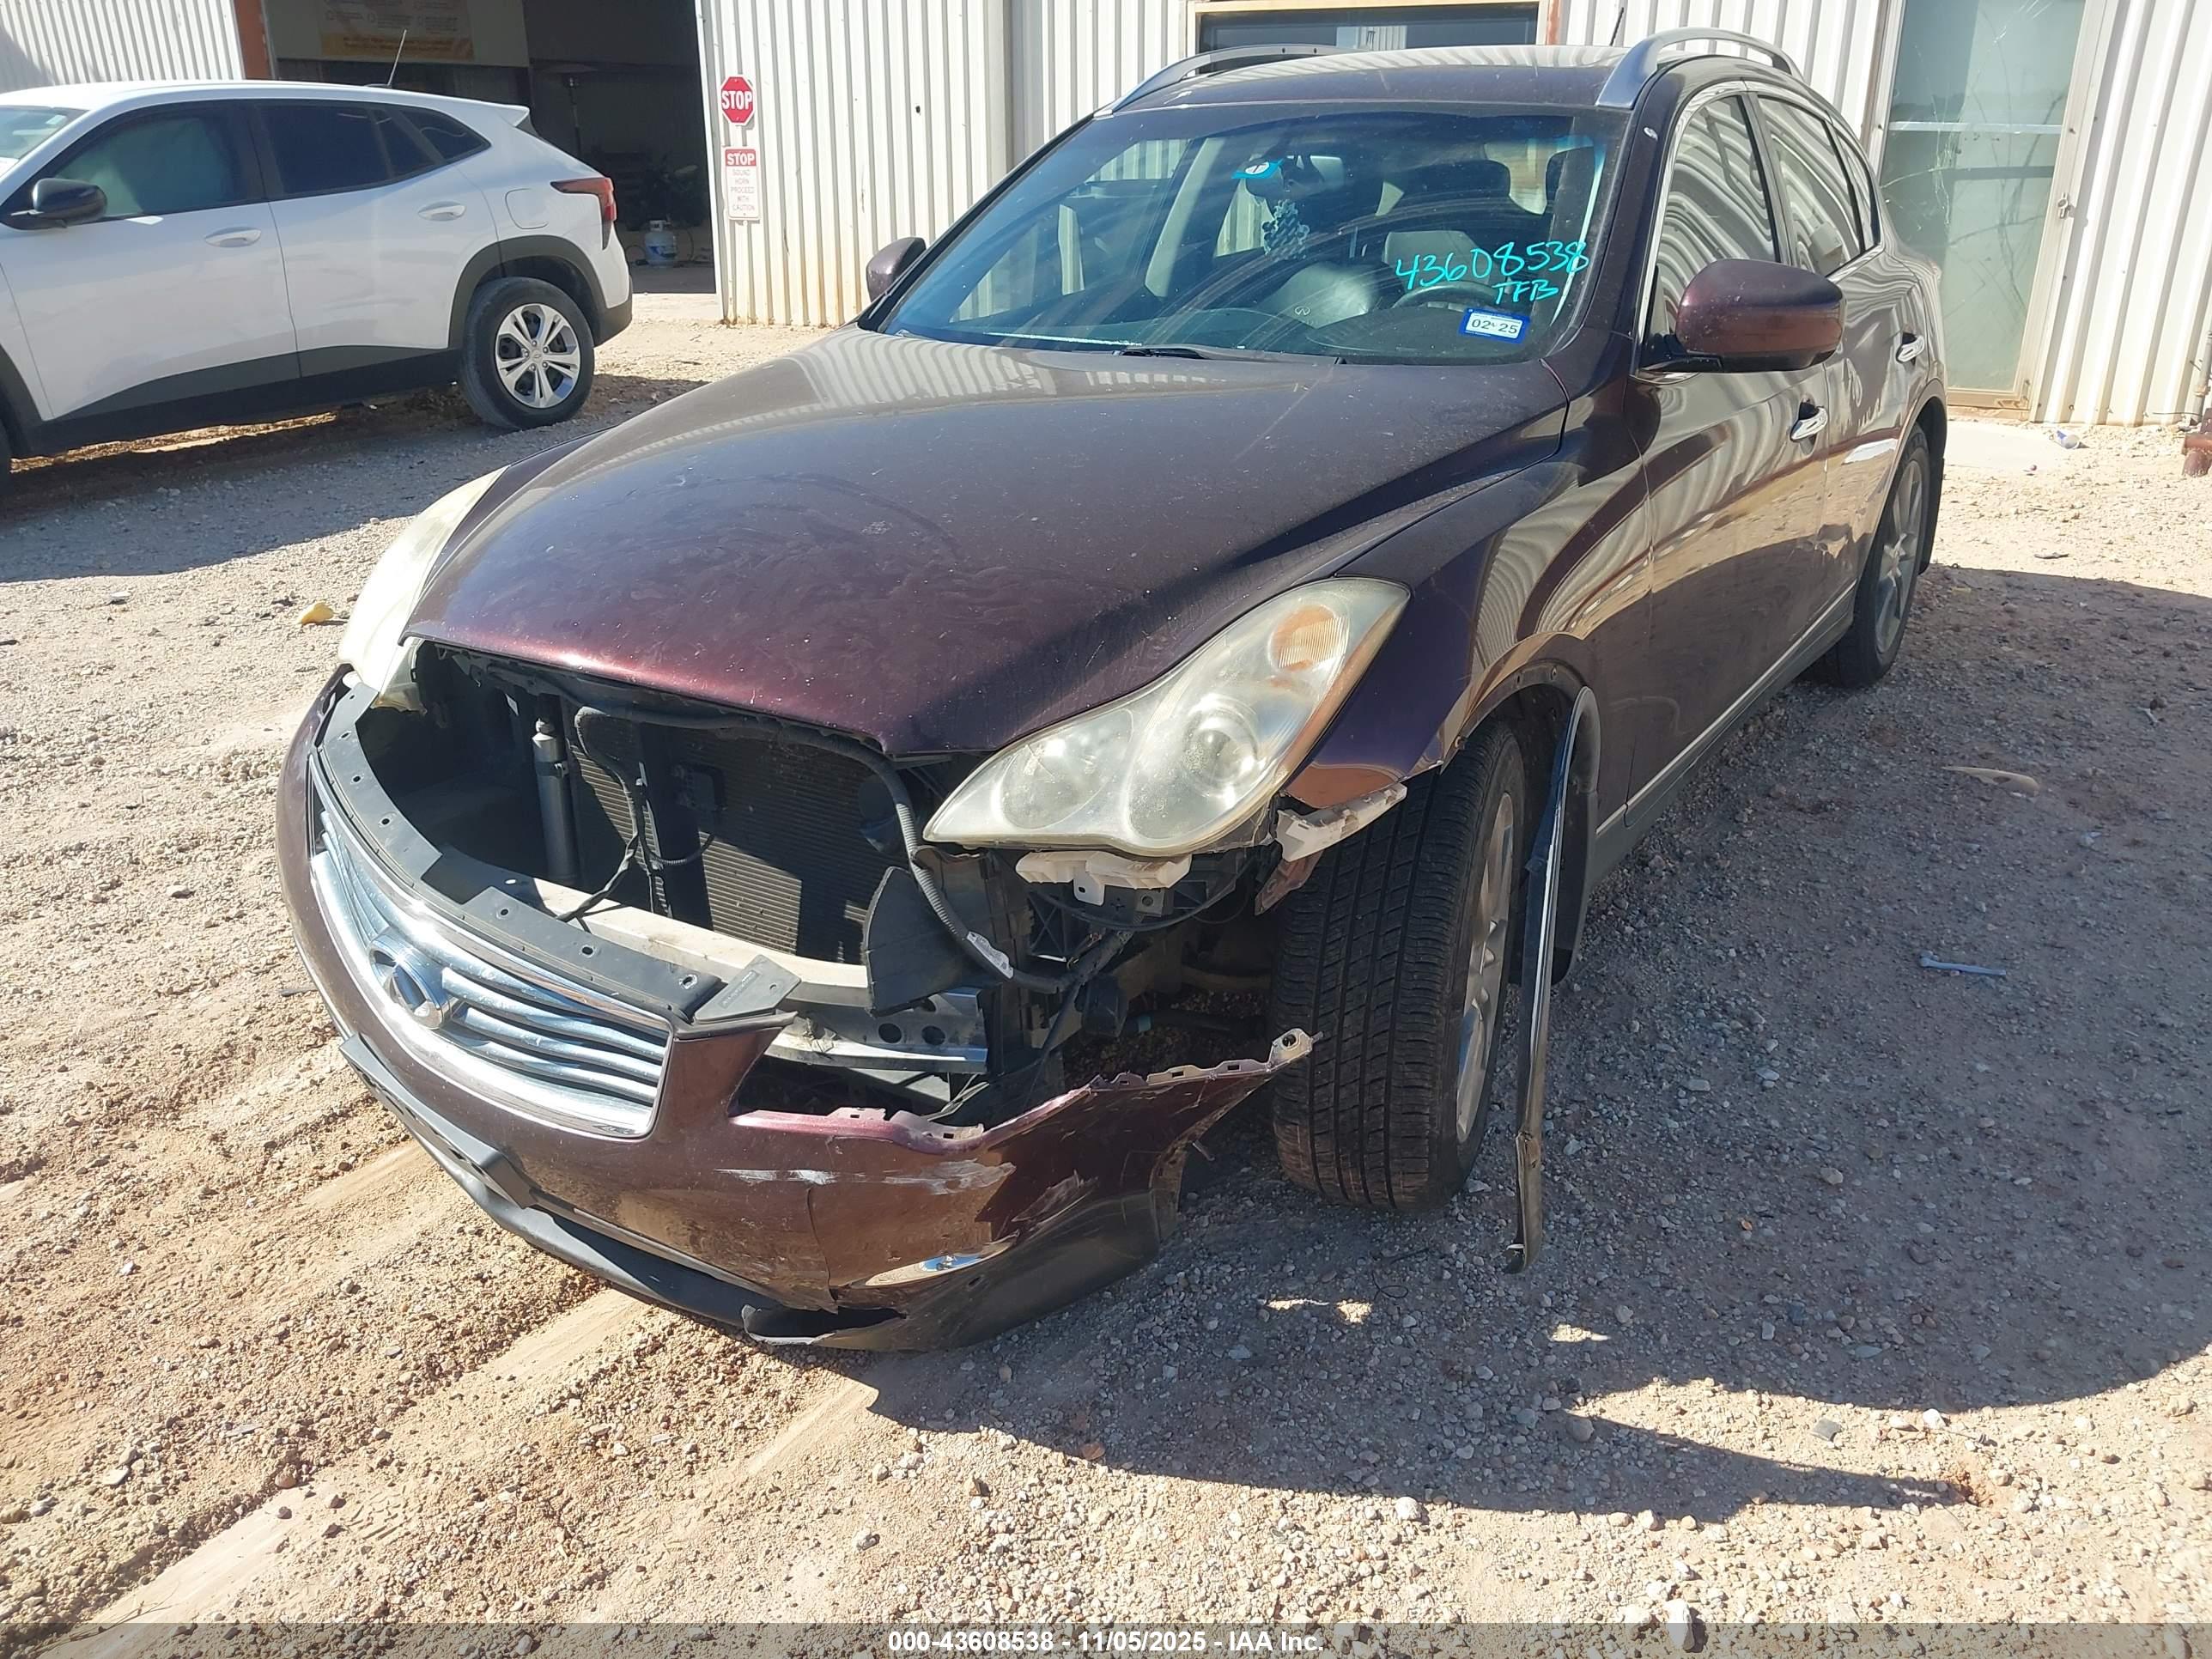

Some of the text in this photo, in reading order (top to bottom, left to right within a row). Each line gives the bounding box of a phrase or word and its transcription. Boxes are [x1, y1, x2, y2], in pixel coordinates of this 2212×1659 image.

[721, 90, 752, 110] STOP
[726, 152, 756, 166] STOP
[1395, 241, 1589, 290] 43608538
[1491, 279, 1560, 305] TFB
[1471, 319, 1492, 330] 02
[1498, 323, 1519, 334] 25
